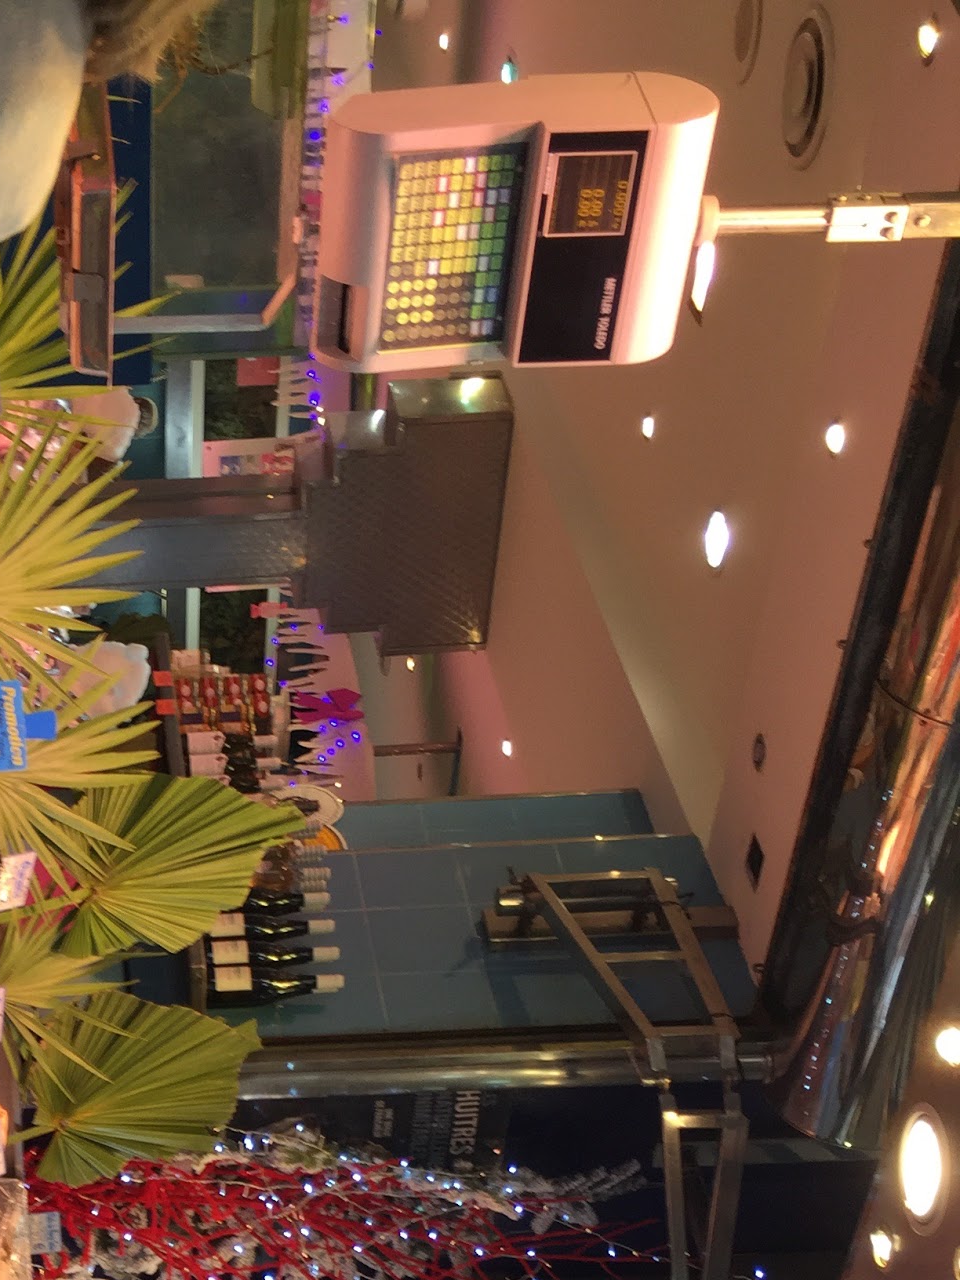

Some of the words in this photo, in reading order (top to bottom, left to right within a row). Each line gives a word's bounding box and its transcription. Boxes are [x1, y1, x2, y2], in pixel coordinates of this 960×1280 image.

[600, 278, 617, 314] METTLER
[594, 317, 609, 350] TOLEDO
[1, 686, 24, 766] Promotion
[449, 1090, 481, 1155] HUITRES
